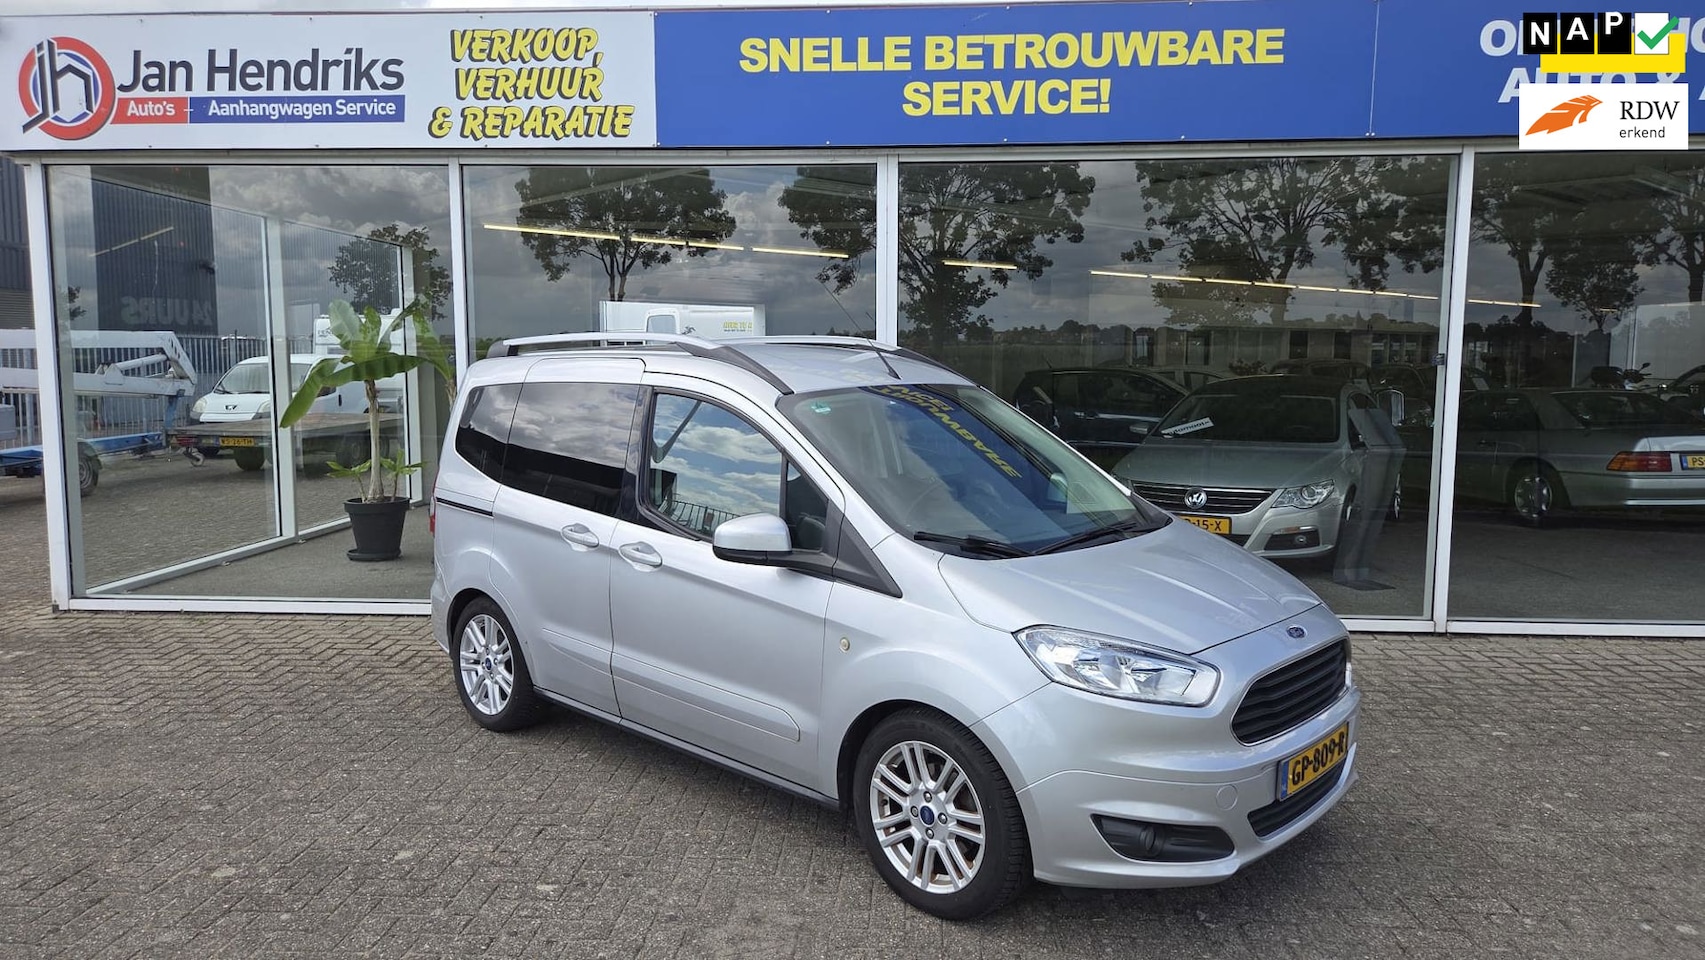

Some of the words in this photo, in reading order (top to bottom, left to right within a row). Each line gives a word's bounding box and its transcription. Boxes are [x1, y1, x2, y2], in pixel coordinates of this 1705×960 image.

[451, 27, 604, 66] VERKOOP,
[739, 36, 911, 73] SNELLE
[925, 28, 1285, 70] BETROUWBARE
[117, 50, 193, 92] Jan
[207, 48, 405, 92] Hendriks
[455, 66, 605, 102] VERHUUR
[127, 100, 176, 116] Auto's
[208, 100, 333, 120] Aanhangwagen
[335, 99, 397, 116] Service
[902, 78, 1112, 116] SERVICE!
[428, 106, 453, 138] &
[460, 104, 635, 141] REPARATIE
[1184, 518, 1222, 532] -15-X
[1291, 731, 1346, 787] GP-809-R
